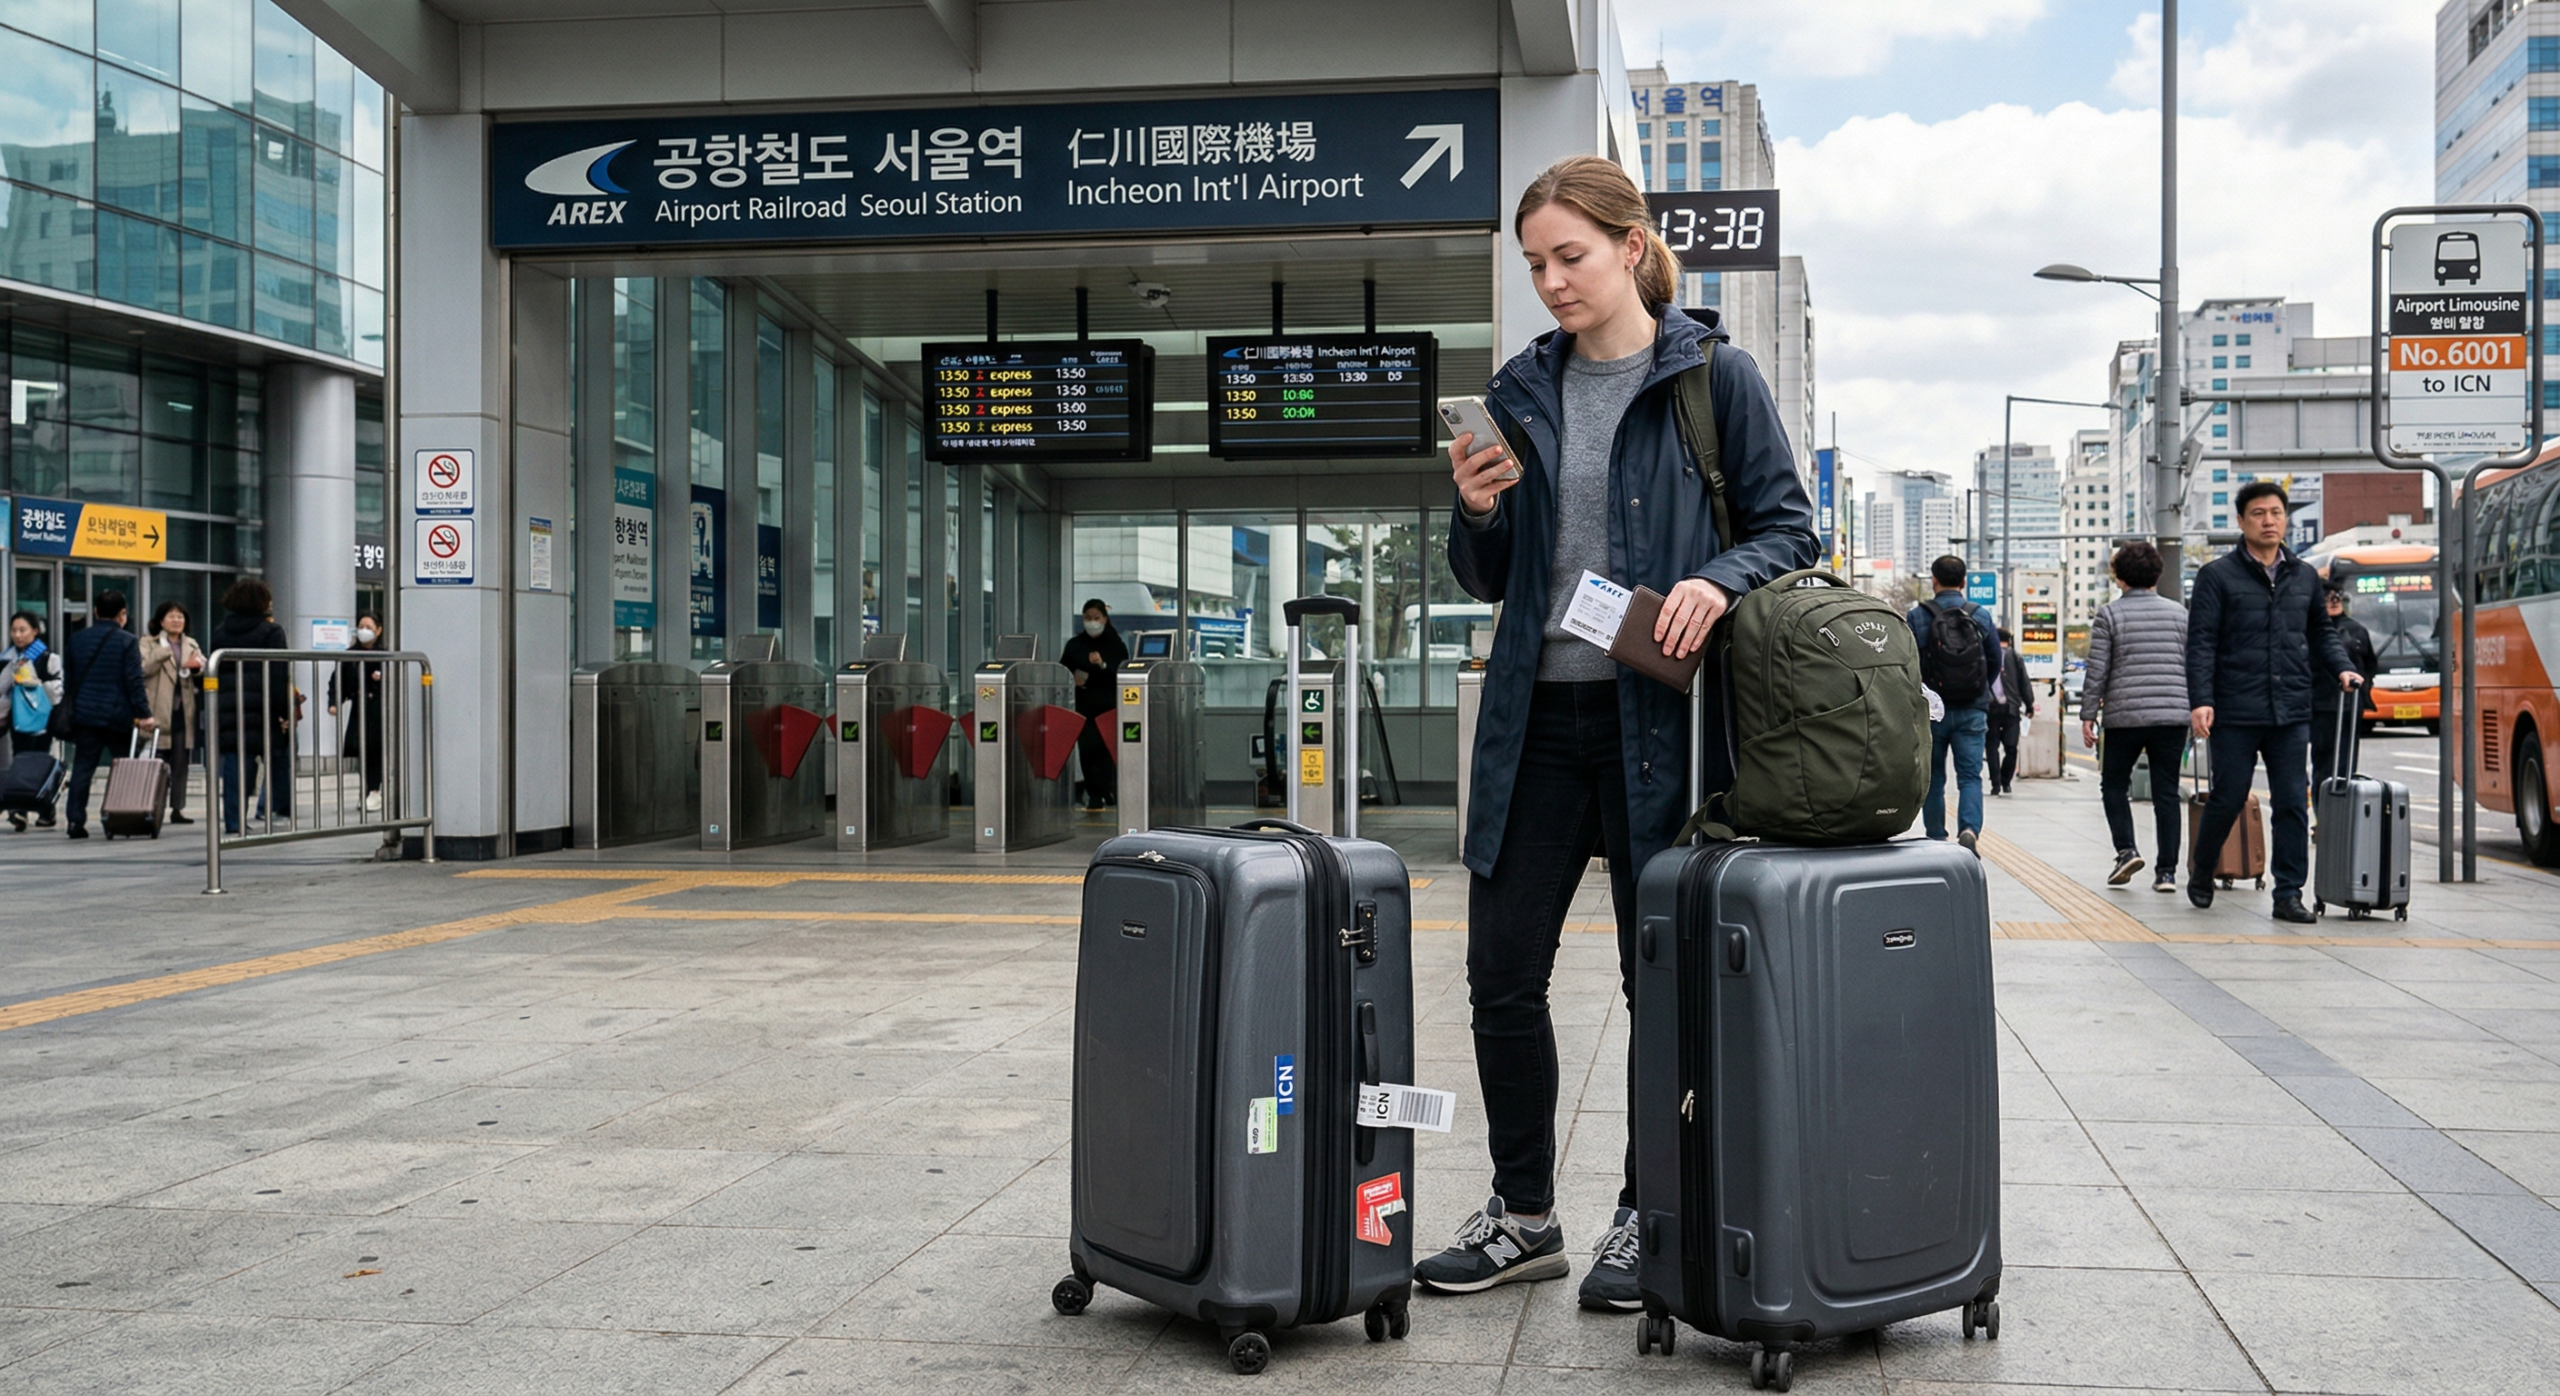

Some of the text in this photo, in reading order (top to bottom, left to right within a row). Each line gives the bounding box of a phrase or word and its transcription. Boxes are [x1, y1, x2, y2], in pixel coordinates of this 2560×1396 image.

[653, 126, 1023, 190] 공항철도 서울역
[1067, 120, 1318, 169] 仁川國際機場
[1067, 171, 1364, 206] Incheon Int'l Airport
[547, 200, 627, 227] AREX
[655, 190, 1023, 228] Airport Railroad Seoul Station
[2395, 296, 2520, 316] Airport Limousine
[2400, 340, 2513, 367] No.6001
[2422, 375, 2492, 393] to ICN
[1278, 1065, 1294, 1104] ICN
[1375, 1092, 1390, 1119] ICN
